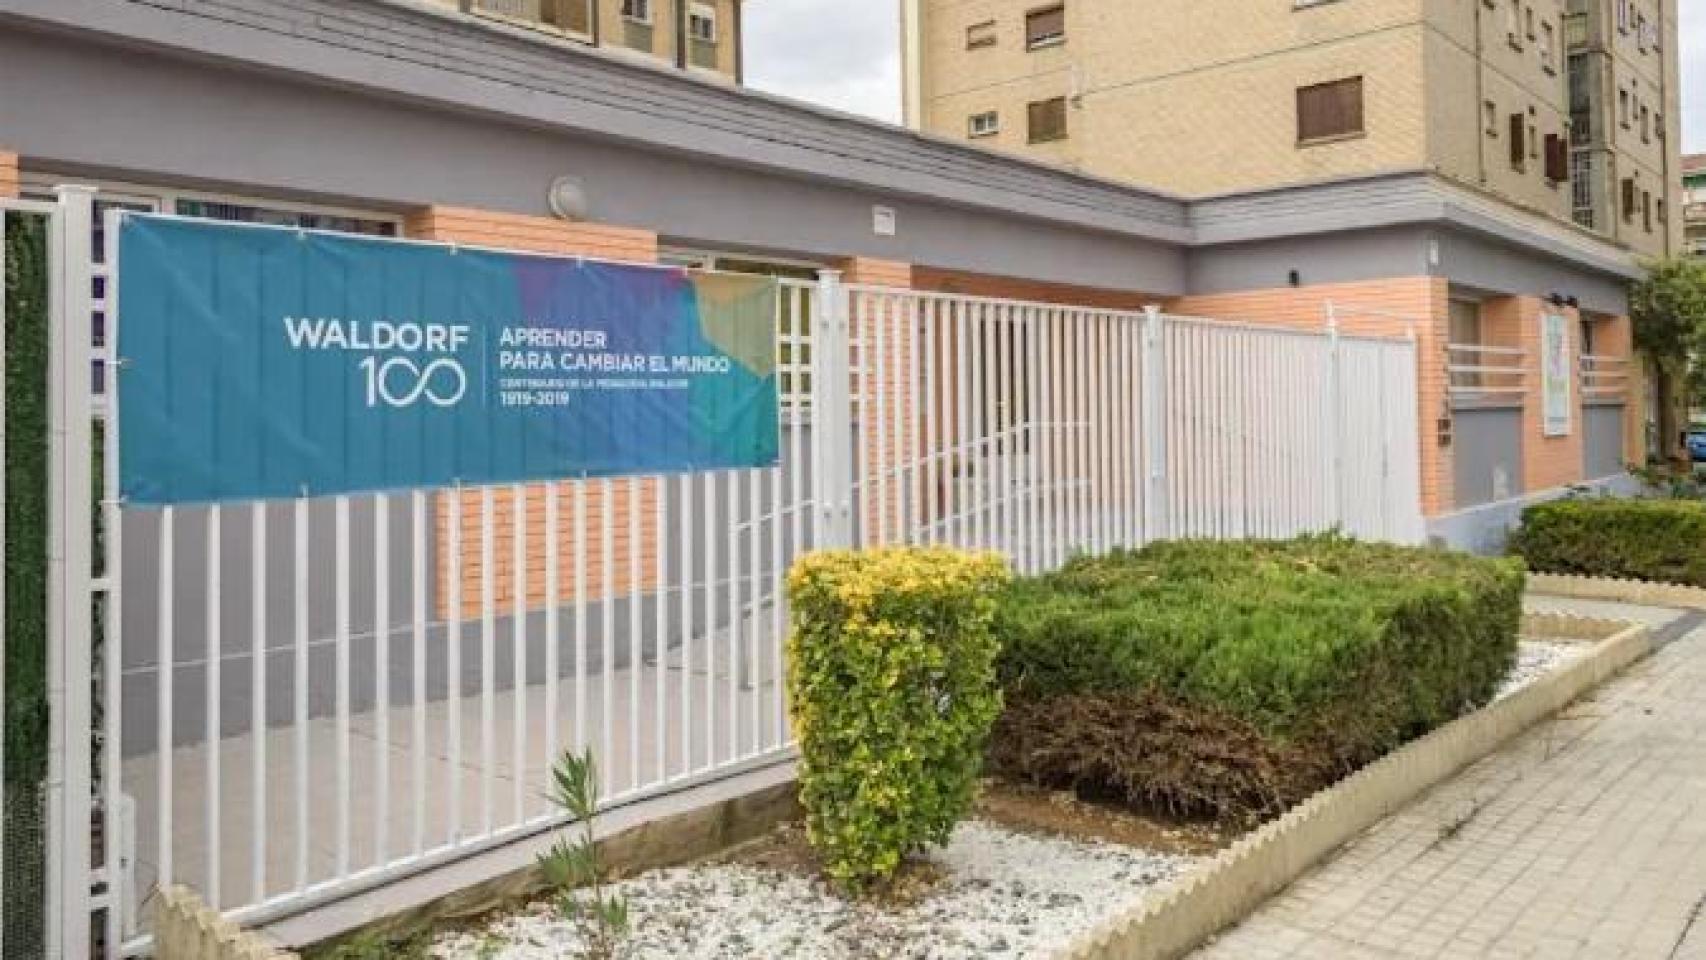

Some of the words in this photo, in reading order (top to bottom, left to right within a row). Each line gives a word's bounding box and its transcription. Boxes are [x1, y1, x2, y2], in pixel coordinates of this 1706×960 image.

[284, 315, 470, 351] WALDORF
[501, 327, 607, 348] APRENDER
[501, 351, 555, 370] PARA
[560, 353, 645, 372] CAMBIAR
[649, 355, 668, 372] EL
[671, 355, 731, 374] MUNDO
[358, 355, 466, 407] 100
[501, 391, 570, 406] 1919-2019
